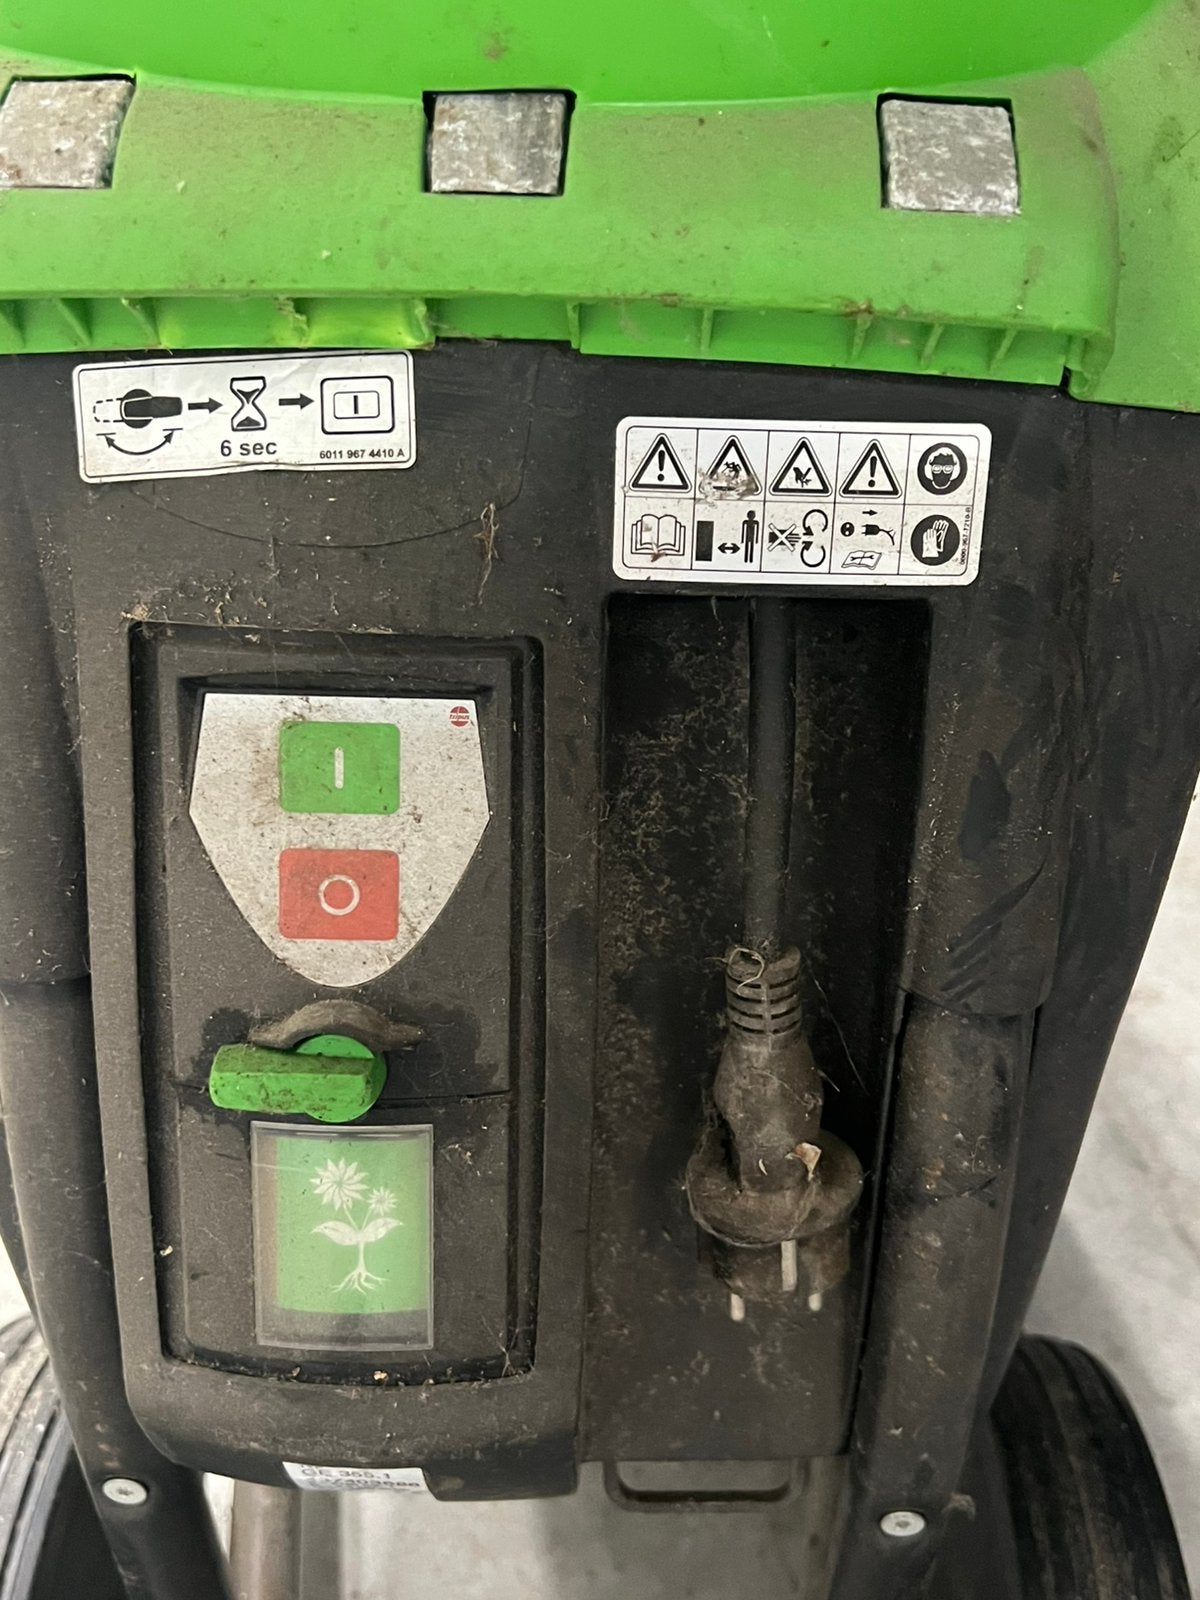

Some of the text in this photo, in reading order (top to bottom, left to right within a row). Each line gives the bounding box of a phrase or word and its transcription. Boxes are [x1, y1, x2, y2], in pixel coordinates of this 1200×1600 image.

[220, 439, 277, 457] 6 sec
[319, 448, 405, 459] 6011 967 4410 A
